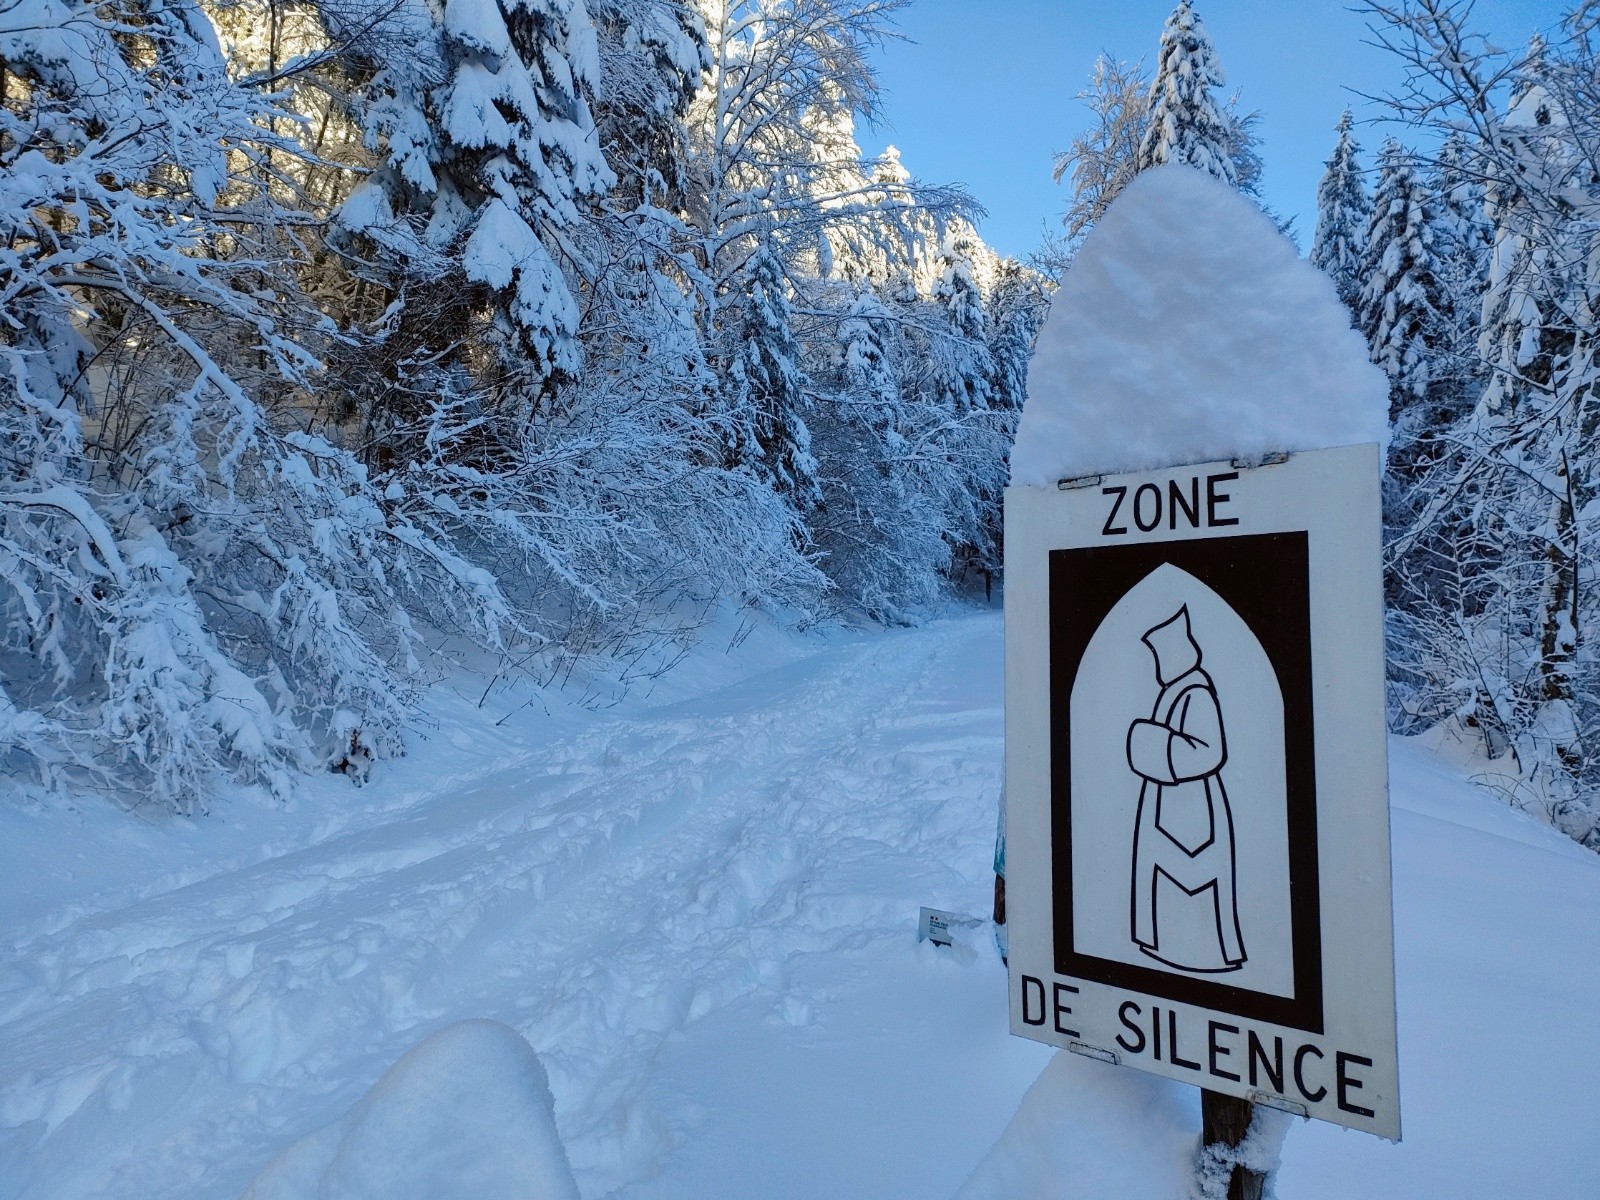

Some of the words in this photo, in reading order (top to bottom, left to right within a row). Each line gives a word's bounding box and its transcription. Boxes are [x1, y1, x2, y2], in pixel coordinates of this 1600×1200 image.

[1102, 472, 1240, 536] ZONE
[1021, 974, 1080, 1038] DE
[1115, 1000, 1375, 1118] SILENCE
